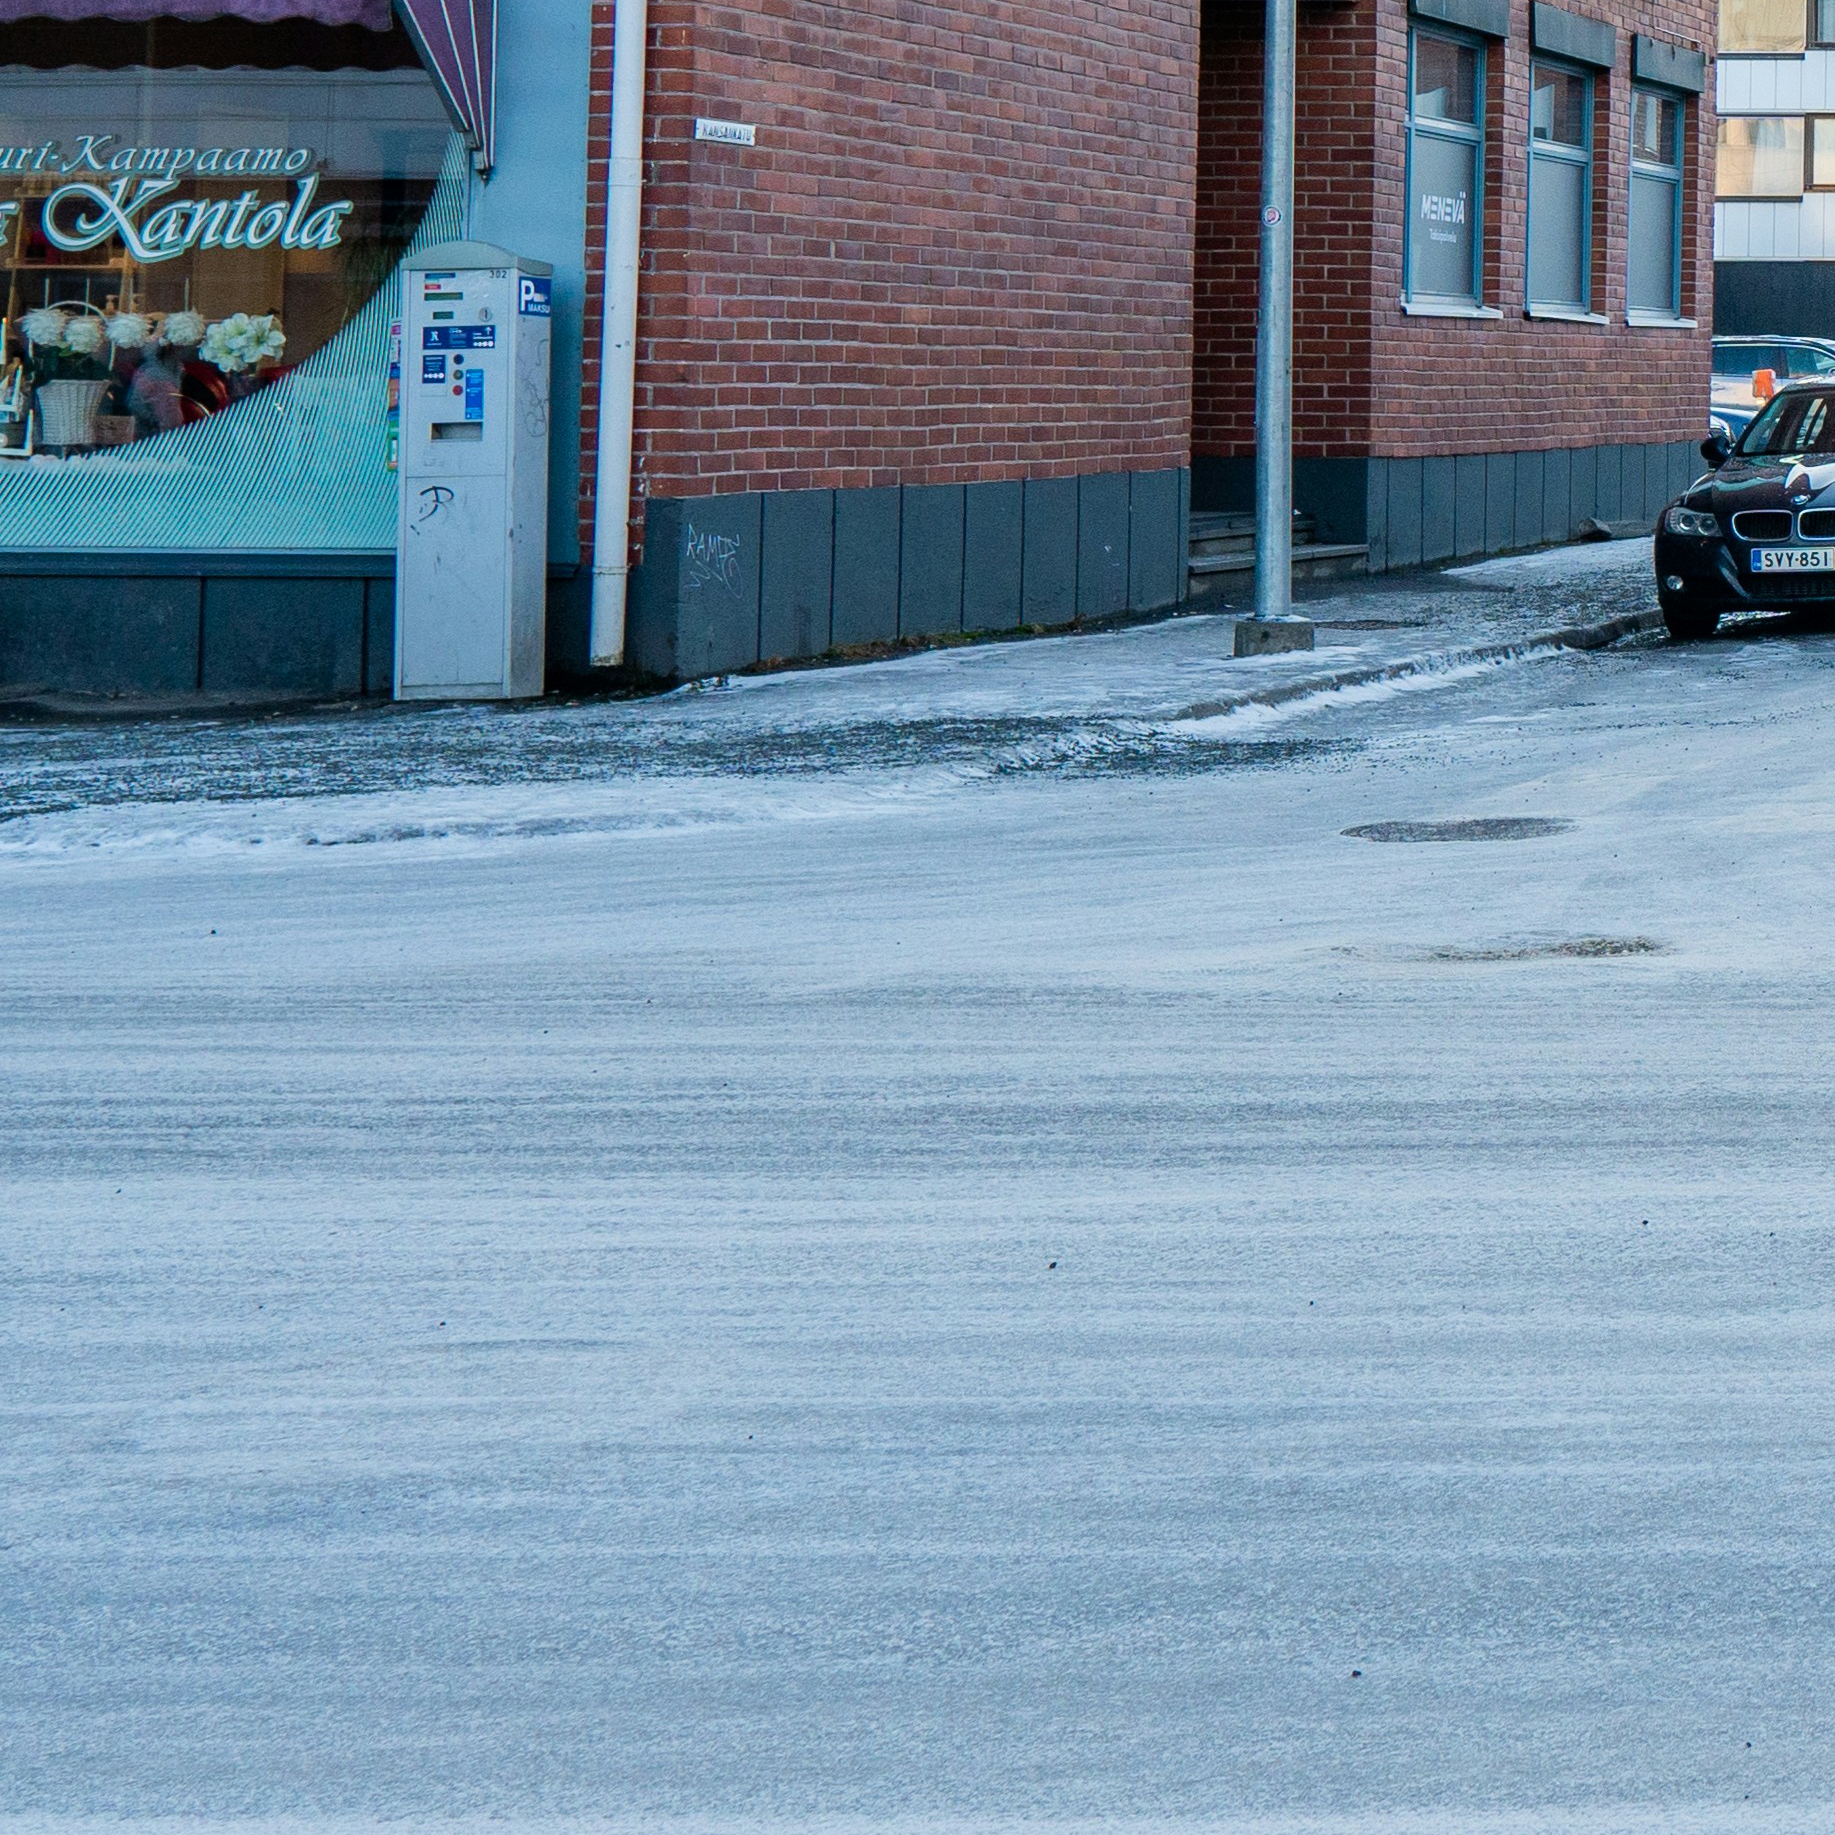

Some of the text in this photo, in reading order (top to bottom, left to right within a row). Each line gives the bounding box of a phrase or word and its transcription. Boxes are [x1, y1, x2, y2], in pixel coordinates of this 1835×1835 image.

[42, 171, 355, 263] Kantola
[1421, 191, 1466, 224] MENEVÄ
[489, 270, 508, 279] 302
[521, 280, 535, 311] P
[1764, 551, 1828, 568] SVY-851
